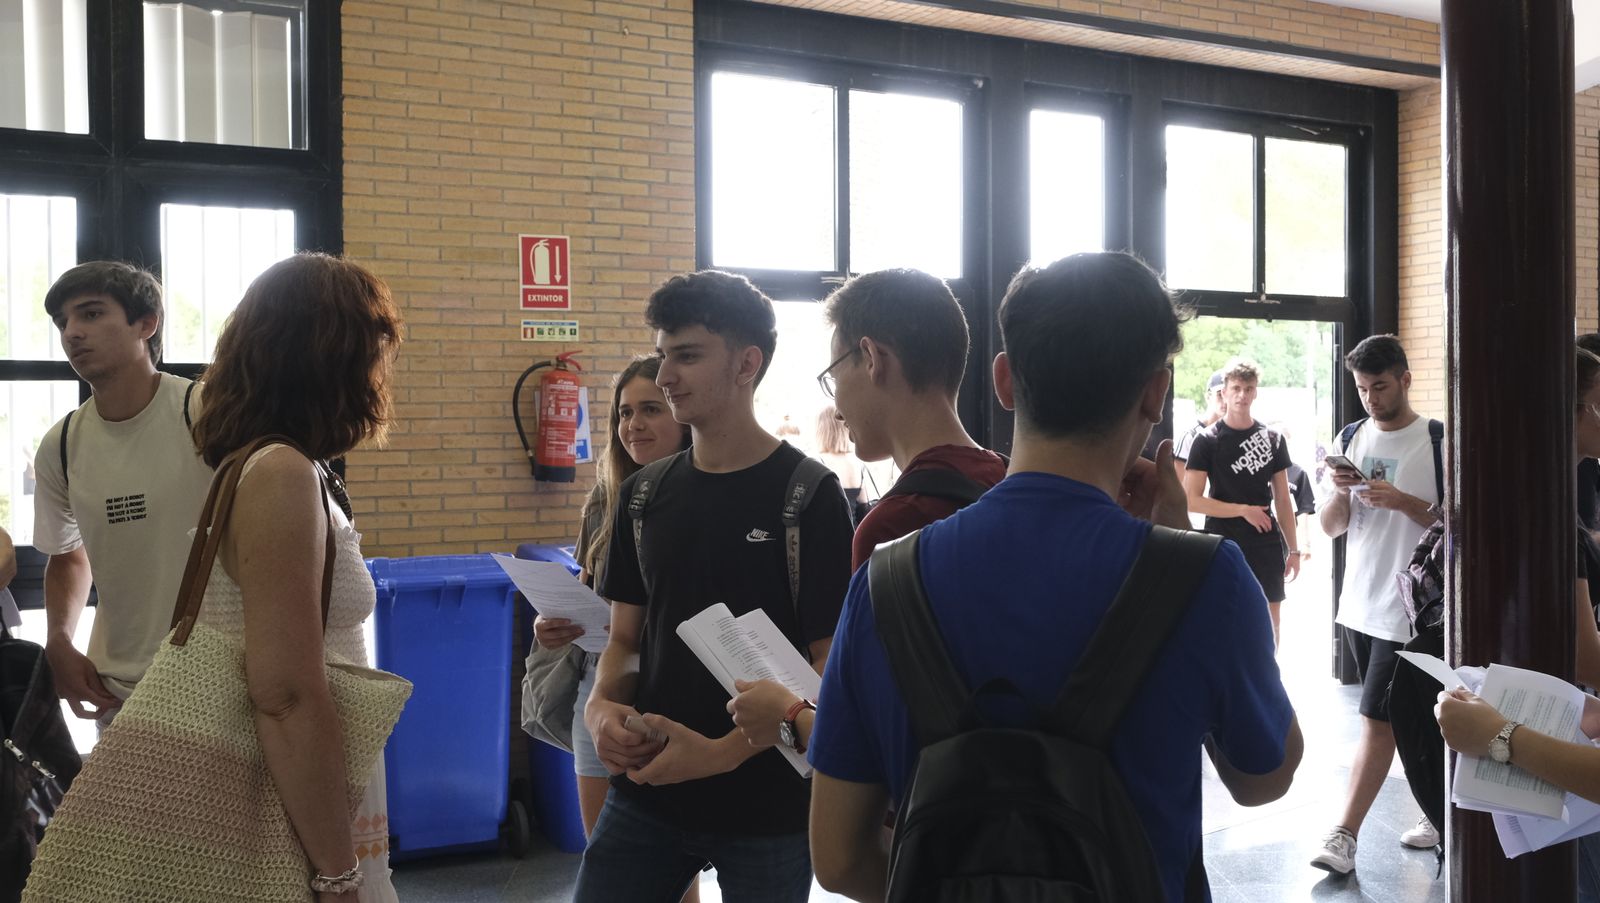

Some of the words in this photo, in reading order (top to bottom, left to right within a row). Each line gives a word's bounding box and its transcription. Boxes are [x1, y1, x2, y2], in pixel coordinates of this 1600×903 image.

[527, 294, 564, 302] EXTINTOR
[1239, 432, 1262, 452] THE
[1230, 439, 1270, 474] NORTH
[1246, 450, 1274, 475] FACE
[750, 528, 770, 538] NIKE
